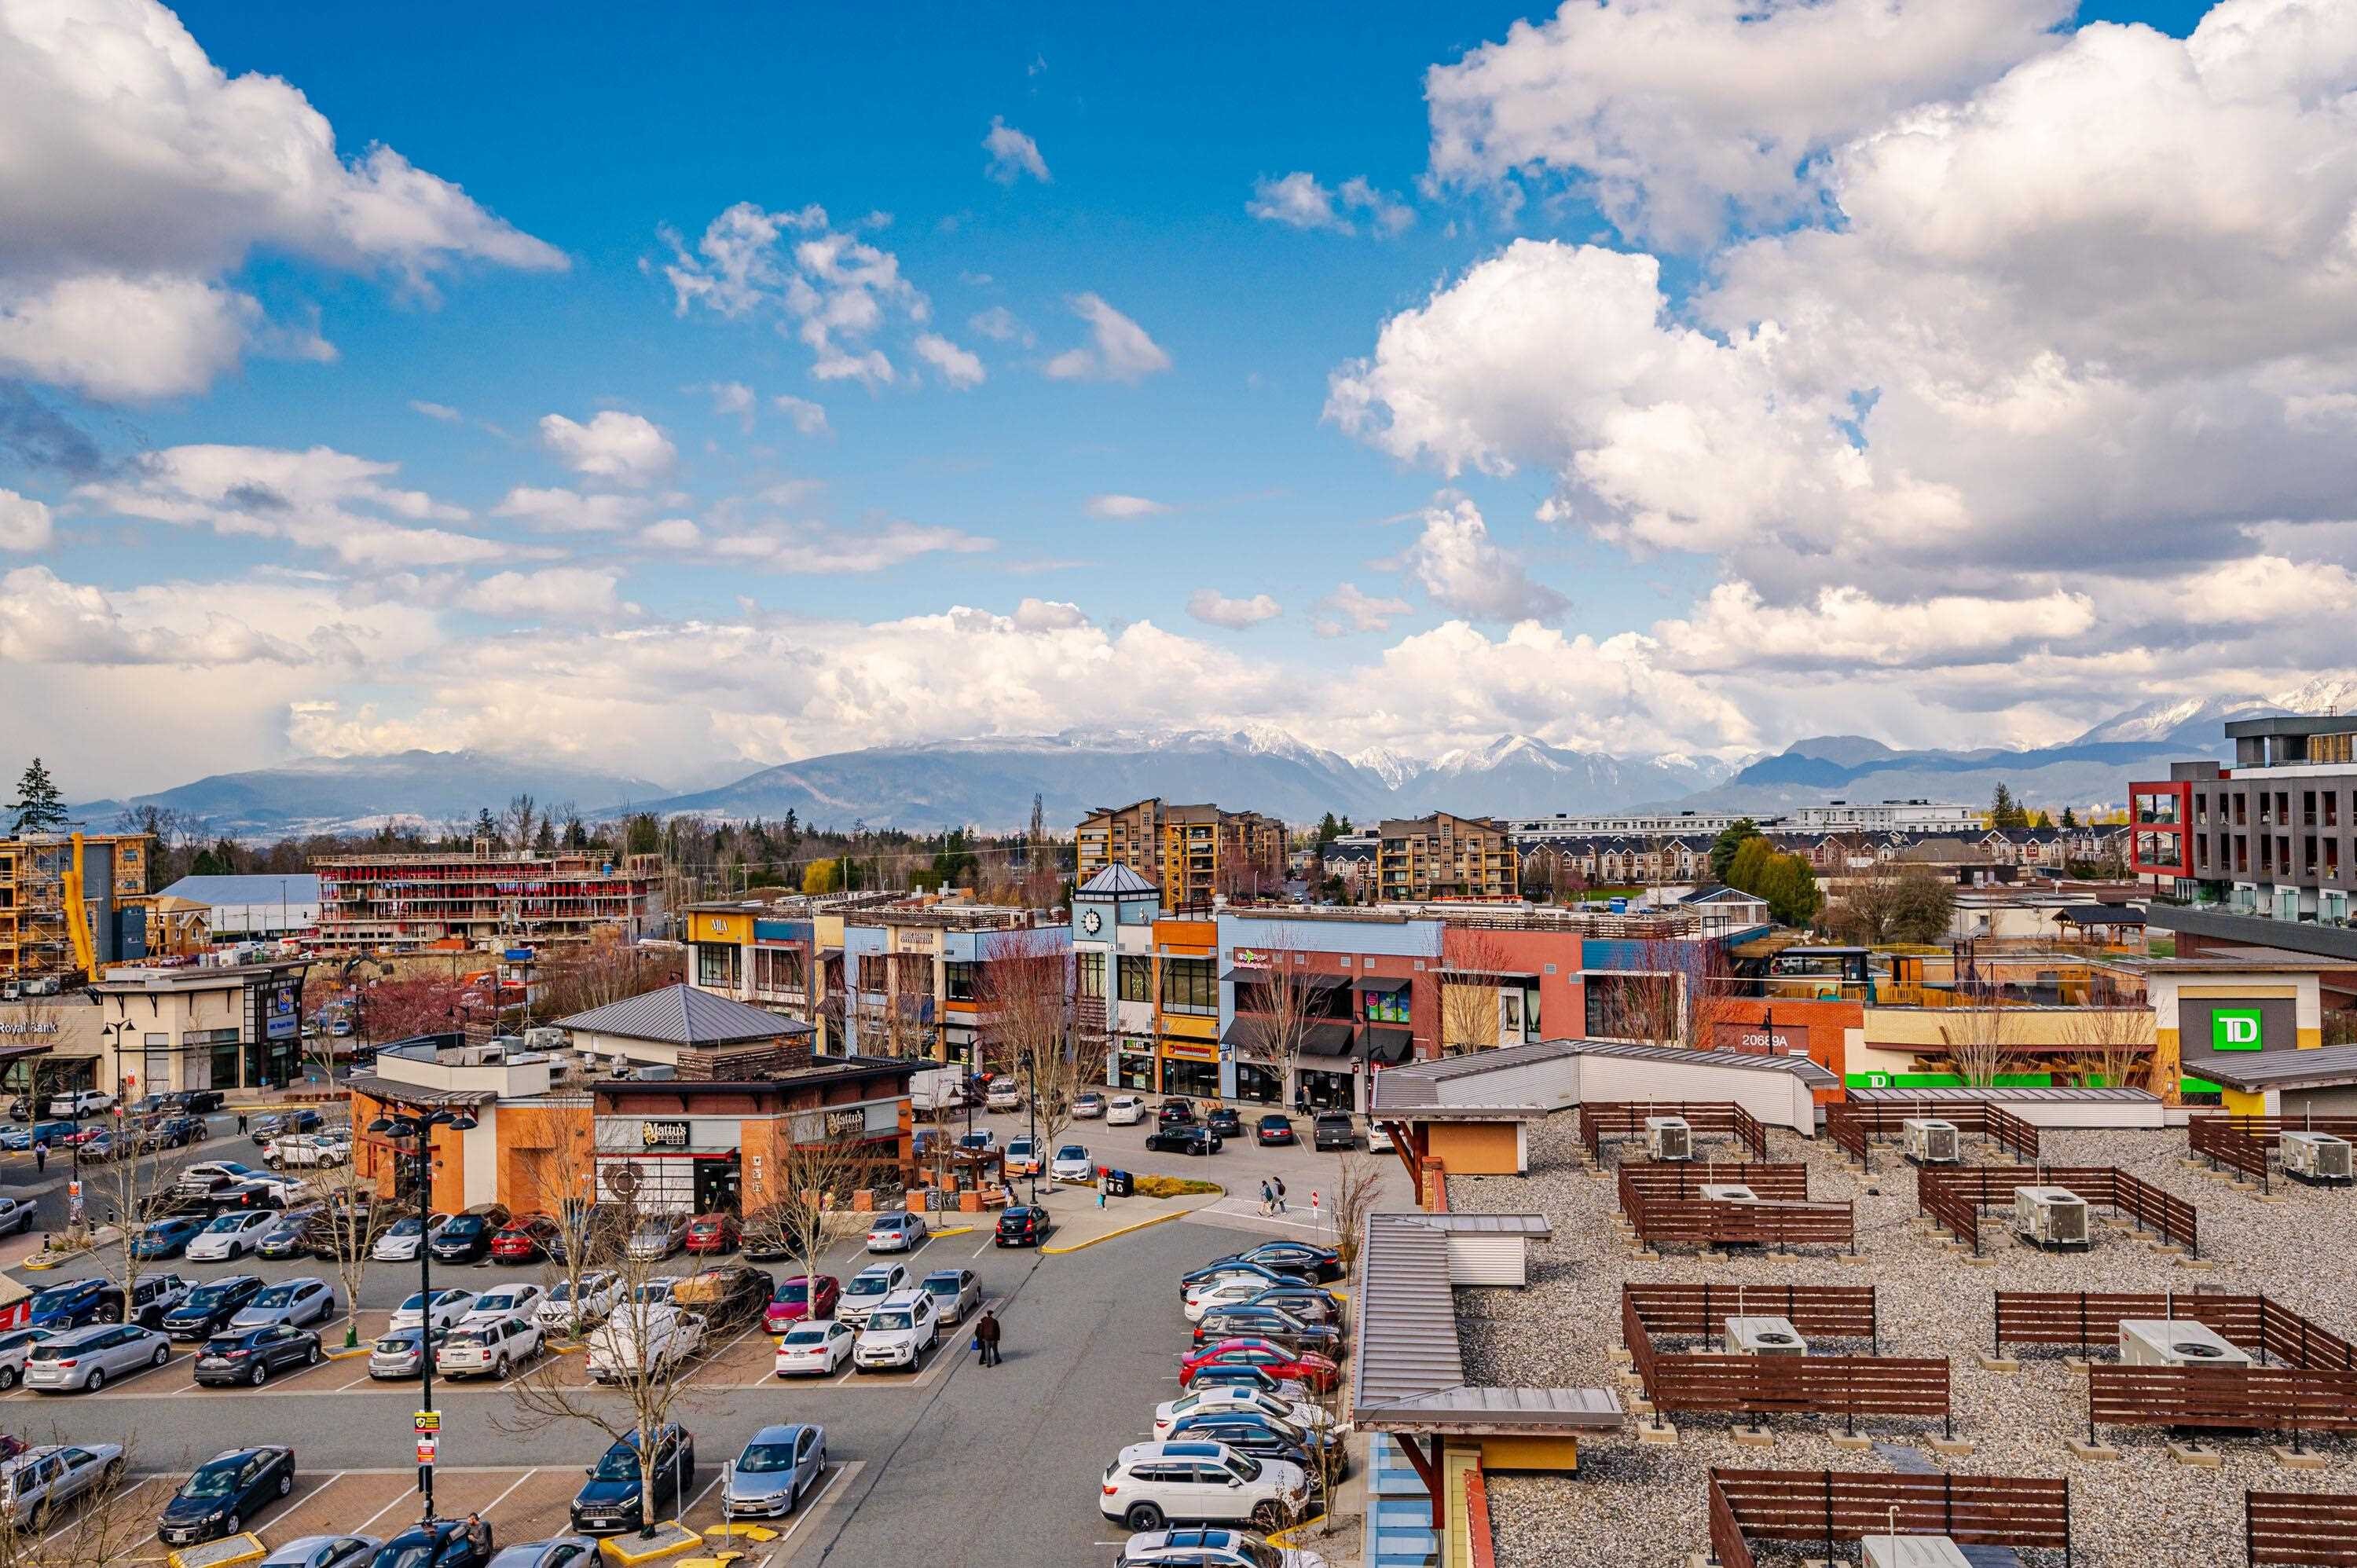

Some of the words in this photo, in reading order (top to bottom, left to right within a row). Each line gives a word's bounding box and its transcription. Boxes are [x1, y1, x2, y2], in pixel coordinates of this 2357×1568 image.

[2218, 1017, 2258, 1042] TD
[1742, 1034, 1788, 1047] 20689A
[1868, 1075, 1886, 1088] TD
[830, 1109, 864, 1126] Mattu's
[645, 1122, 687, 1136] Mattu's
